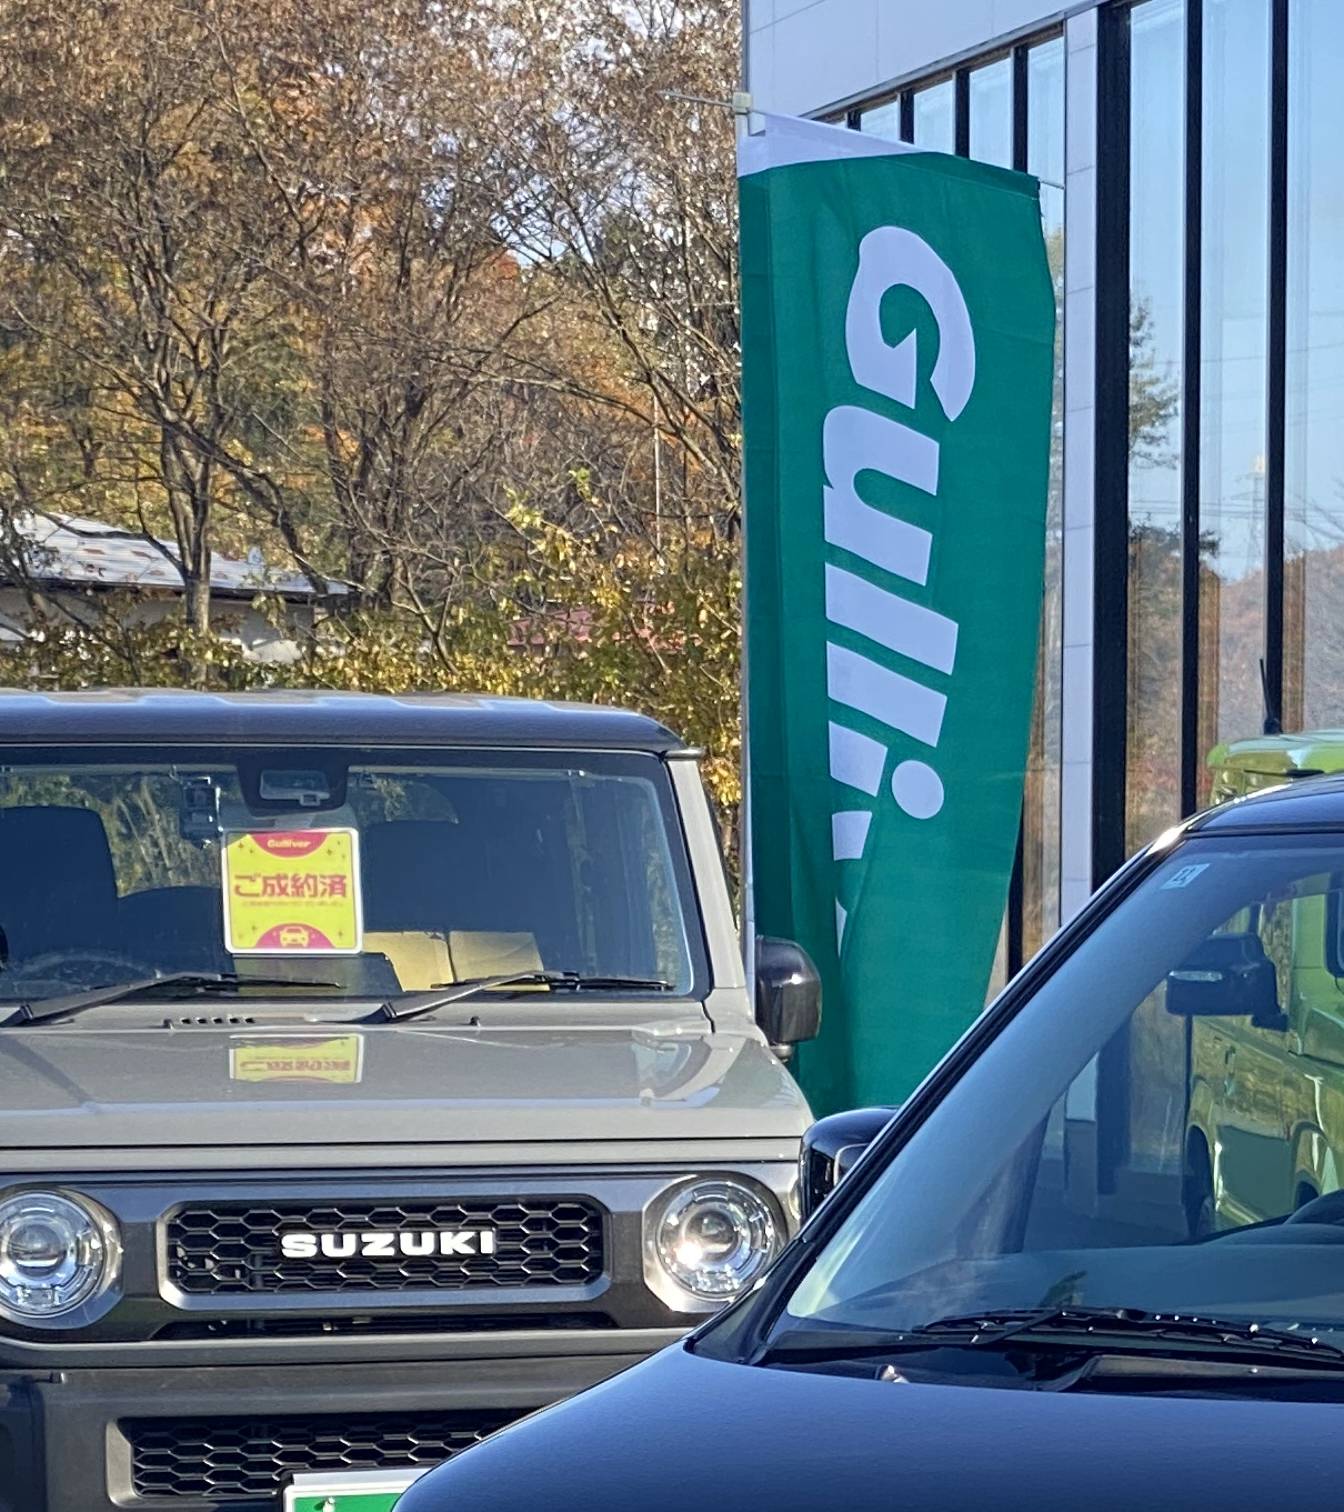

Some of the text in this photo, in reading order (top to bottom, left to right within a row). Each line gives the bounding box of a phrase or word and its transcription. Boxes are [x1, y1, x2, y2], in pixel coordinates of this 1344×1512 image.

[267, 838, 312, 849] Gulliver
[234, 872, 348, 899] ご成約済
[281, 1230, 494, 1259] SUZUKI
